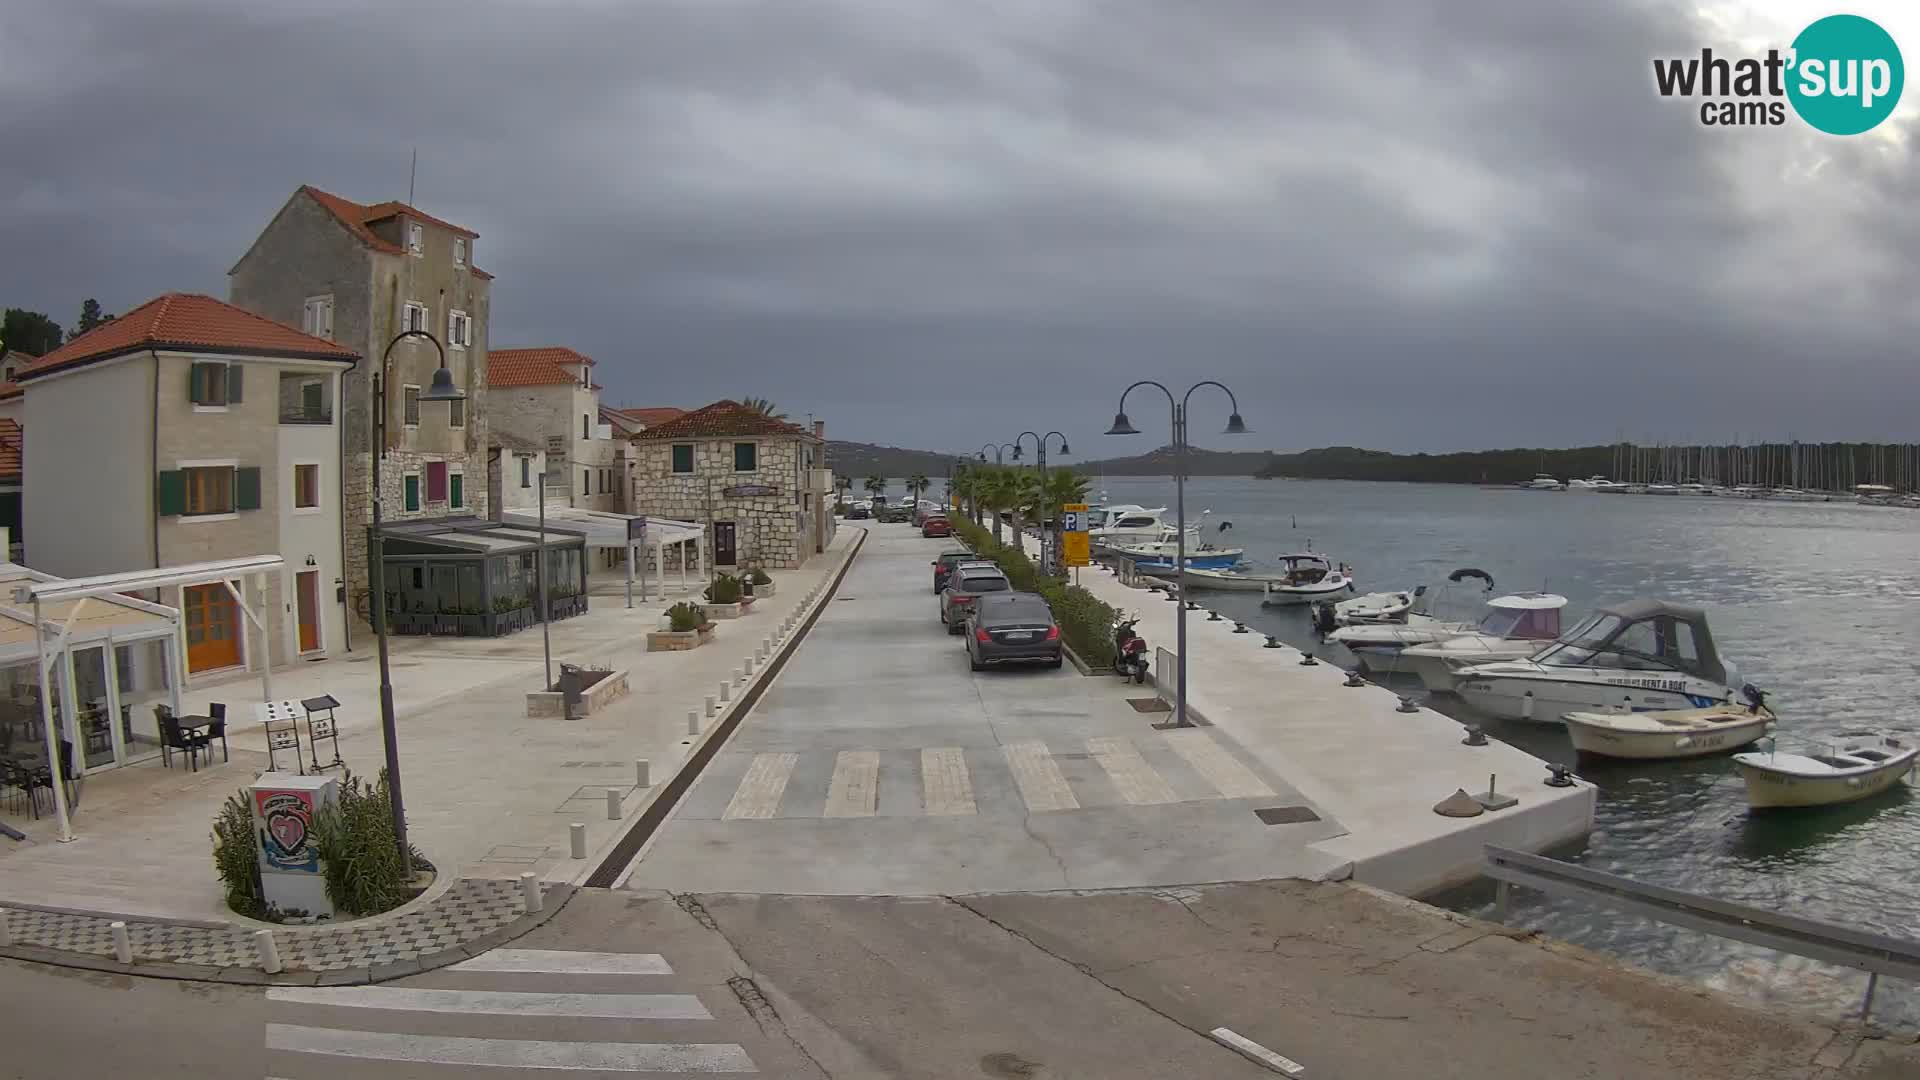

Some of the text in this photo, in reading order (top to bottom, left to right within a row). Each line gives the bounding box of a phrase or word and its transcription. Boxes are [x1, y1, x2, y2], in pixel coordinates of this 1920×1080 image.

[1065, 513, 1076, 529] P
[1641, 678, 1662, 689] RENT
[1662, 680, 1667, 689] A
[1668, 680, 1687, 692] BOAT
